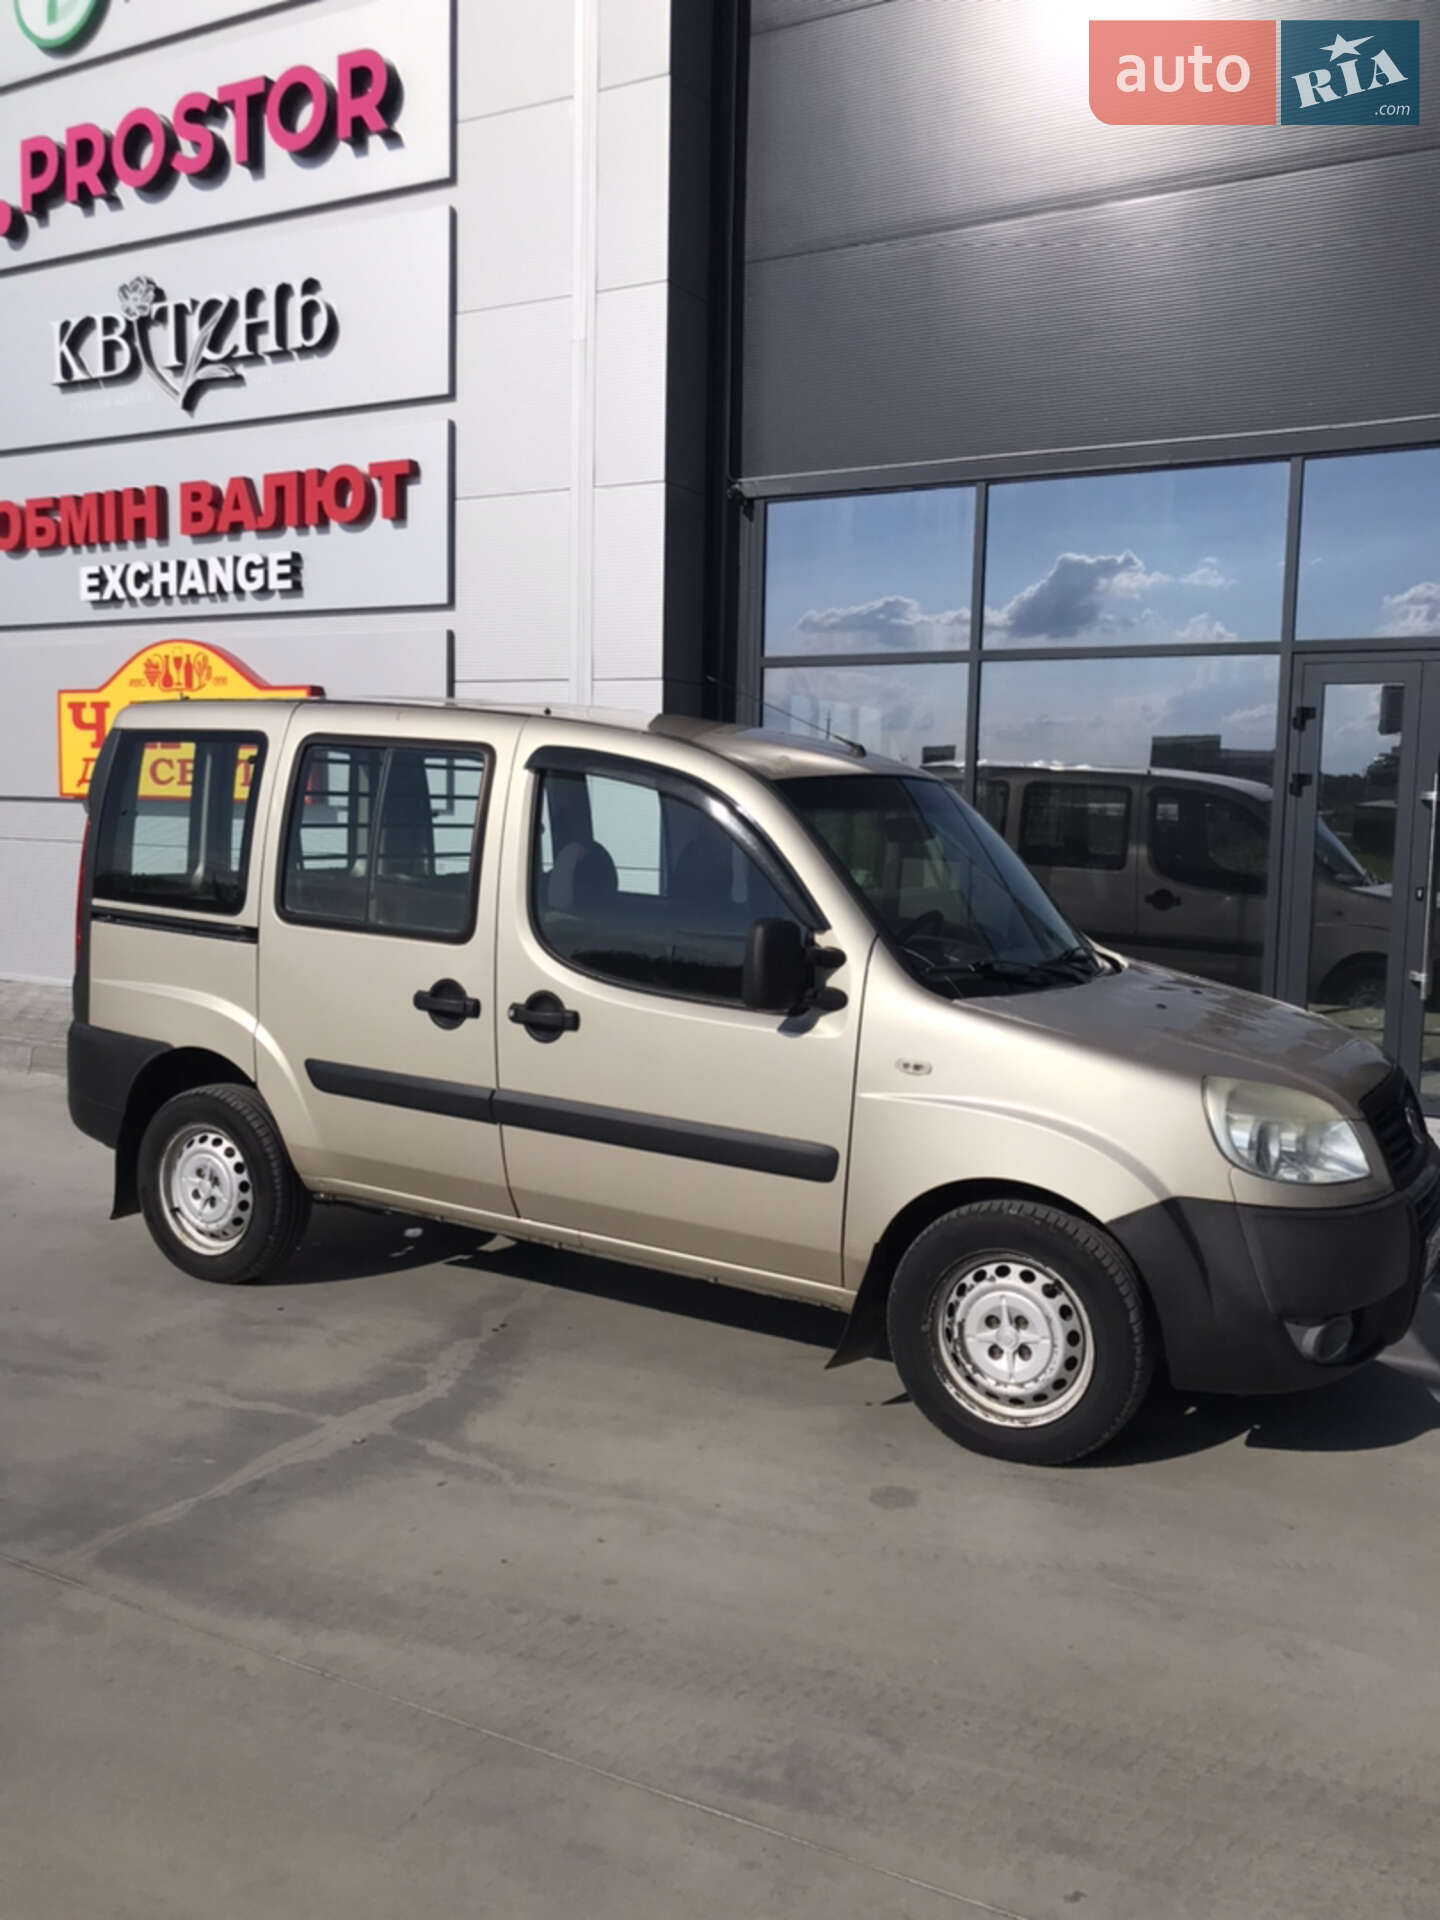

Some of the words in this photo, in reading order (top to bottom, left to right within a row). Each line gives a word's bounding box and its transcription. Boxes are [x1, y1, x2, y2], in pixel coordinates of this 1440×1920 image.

[20, 48, 388, 213] PROSTOR
[0, 486, 157, 552] ОБМІН
[180, 459, 410, 537] ВАЛЮТ
[80, 551, 293, 601] EXCHANGE
